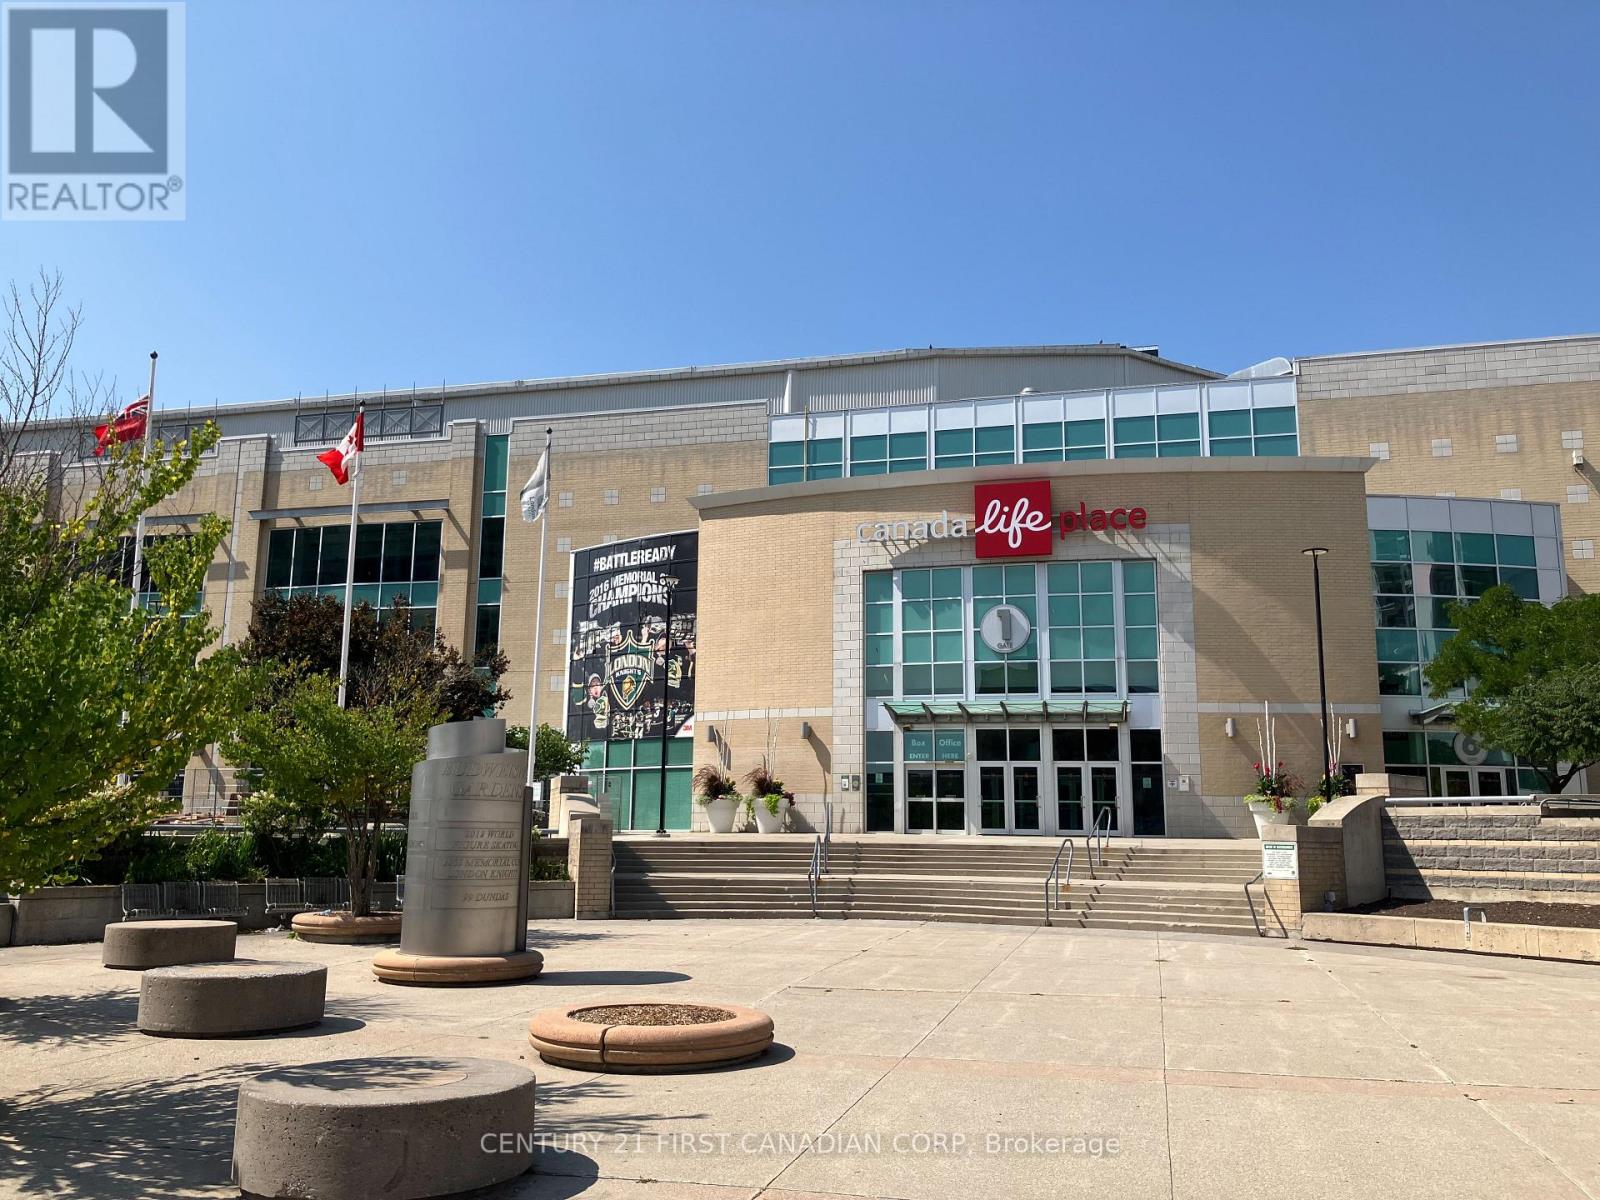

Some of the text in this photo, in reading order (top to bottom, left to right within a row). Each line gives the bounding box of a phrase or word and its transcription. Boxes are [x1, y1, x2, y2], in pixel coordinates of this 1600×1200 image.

[856, 498, 1147, 549] canada life place
[593, 544, 677, 573] #BATTLEREADY
[589, 582, 673, 619] CHAMPIONS
[590, 579, 610, 602] 2016
[610, 570, 659, 589] MEMORIAL
[997, 609, 1011, 640] 1
[609, 653, 652, 678] LONDON
[911, 739, 962, 747] Box Office
